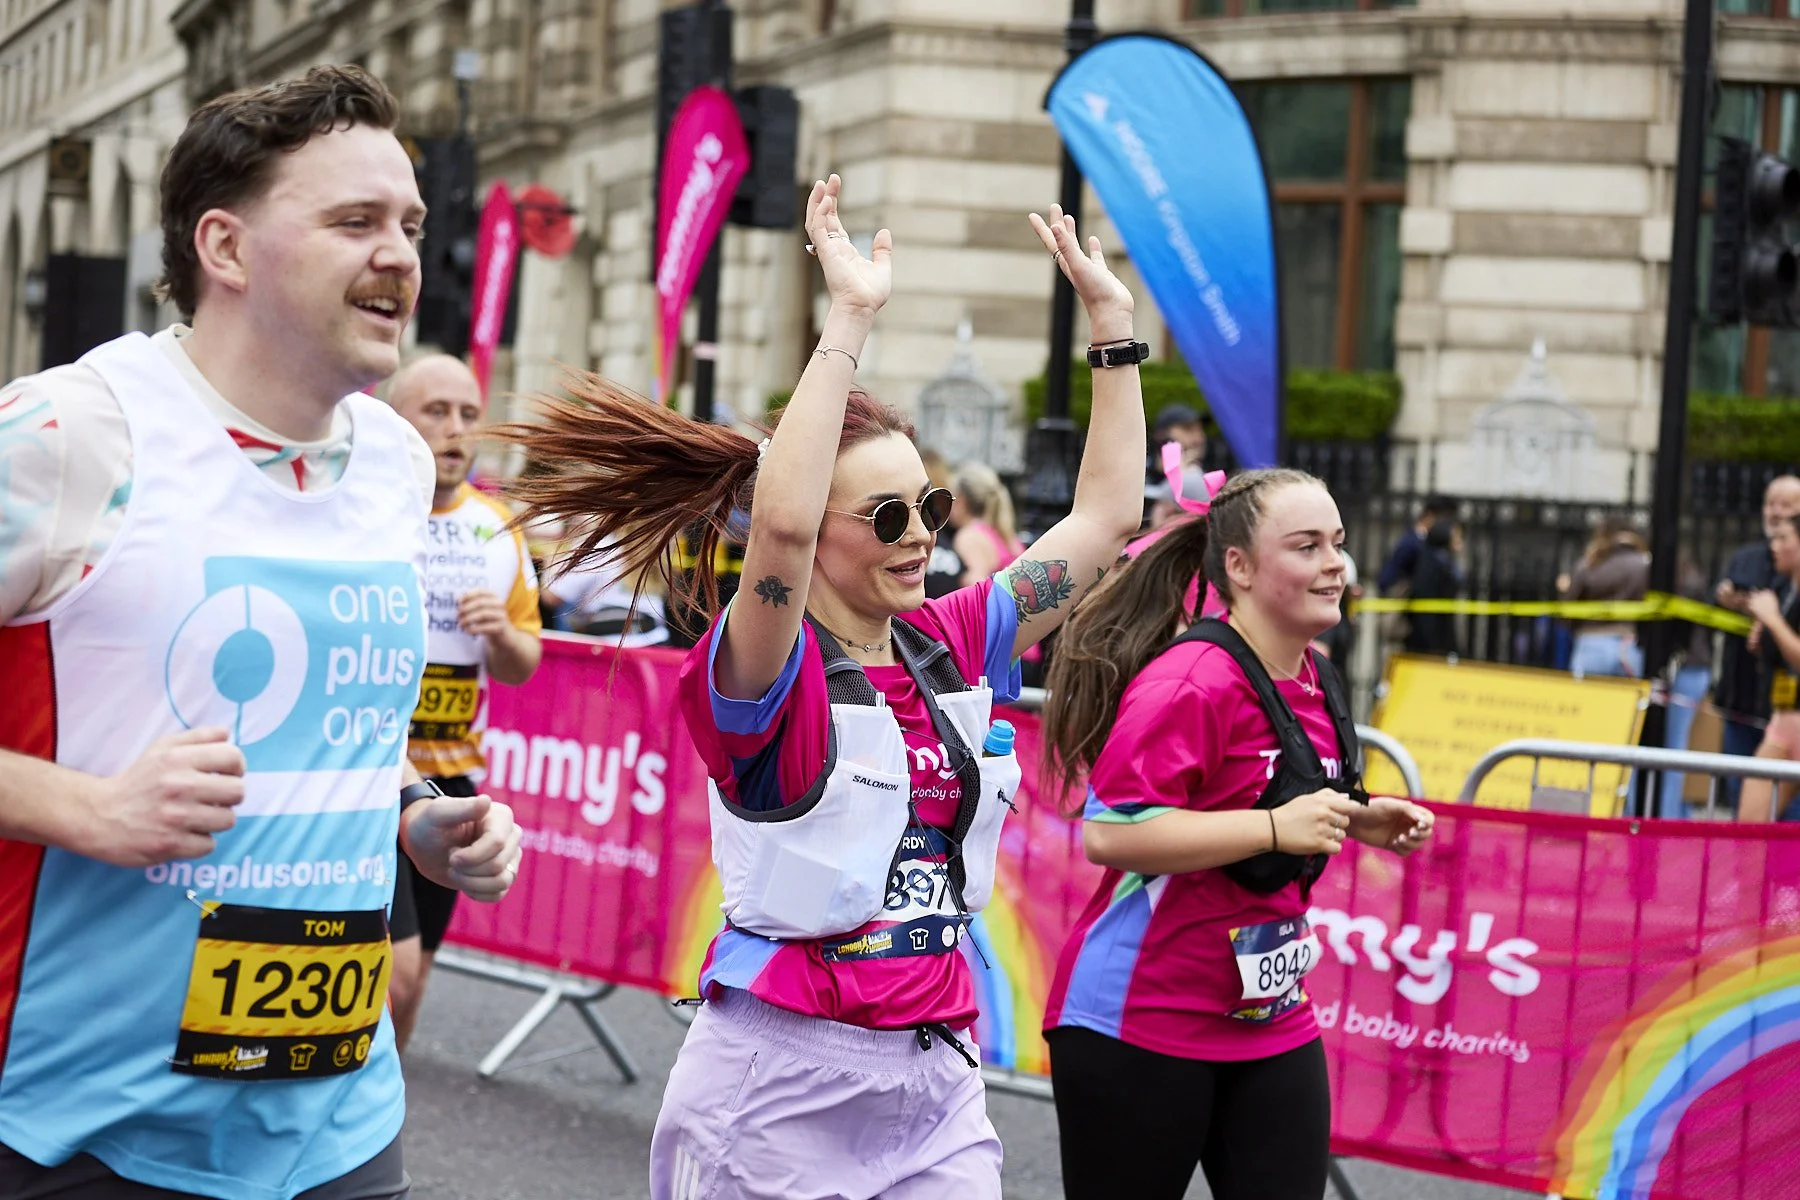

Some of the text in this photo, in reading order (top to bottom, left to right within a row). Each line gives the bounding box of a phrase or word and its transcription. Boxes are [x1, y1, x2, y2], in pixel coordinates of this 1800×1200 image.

[329, 584, 409, 625] one
[325, 634, 415, 696] plus
[419, 686, 473, 713] 979
[322, 706, 399, 747] one
[476, 727, 668, 826] mmy's
[852, 775, 899, 792] SALOMON
[304, 919, 346, 937] TOM
[211, 955, 385, 1019] 12301
[1258, 943, 1311, 992] 8942
[1343, 1004, 1419, 1049] baby
[1423, 1022, 1530, 1064] charity
